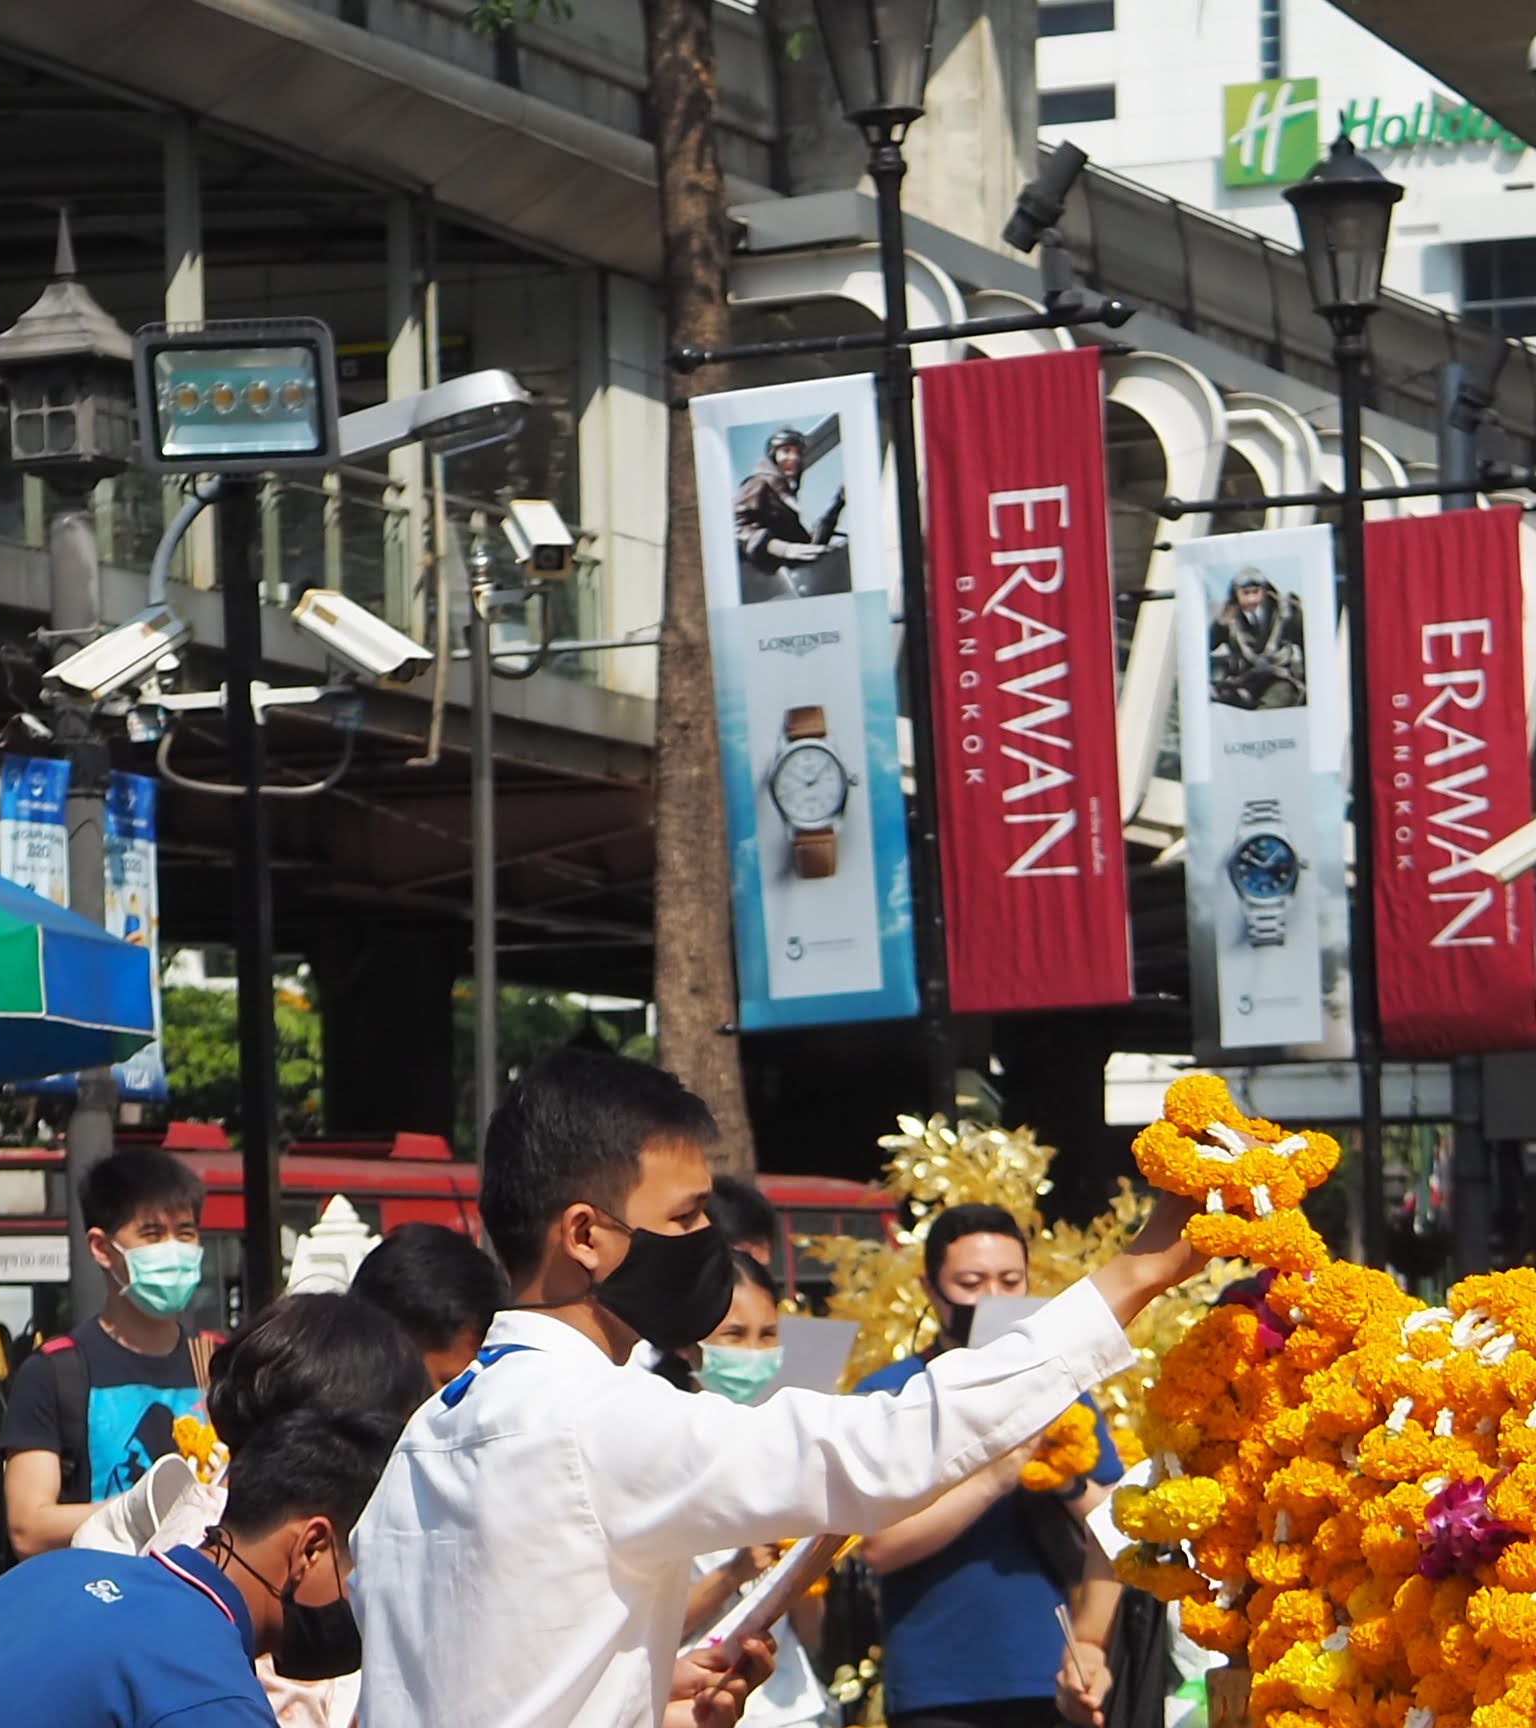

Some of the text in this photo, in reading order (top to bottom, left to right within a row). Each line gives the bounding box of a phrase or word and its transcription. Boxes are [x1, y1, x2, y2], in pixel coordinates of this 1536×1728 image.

[757, 629, 843, 652] LONGINES
[955, 575, 985, 785] BANGKOK
[982, 485, 1080, 878] ERAWAN
[1392, 693, 1413, 871] BANGKOK
[1414, 617, 1495, 947] ERAWAN
